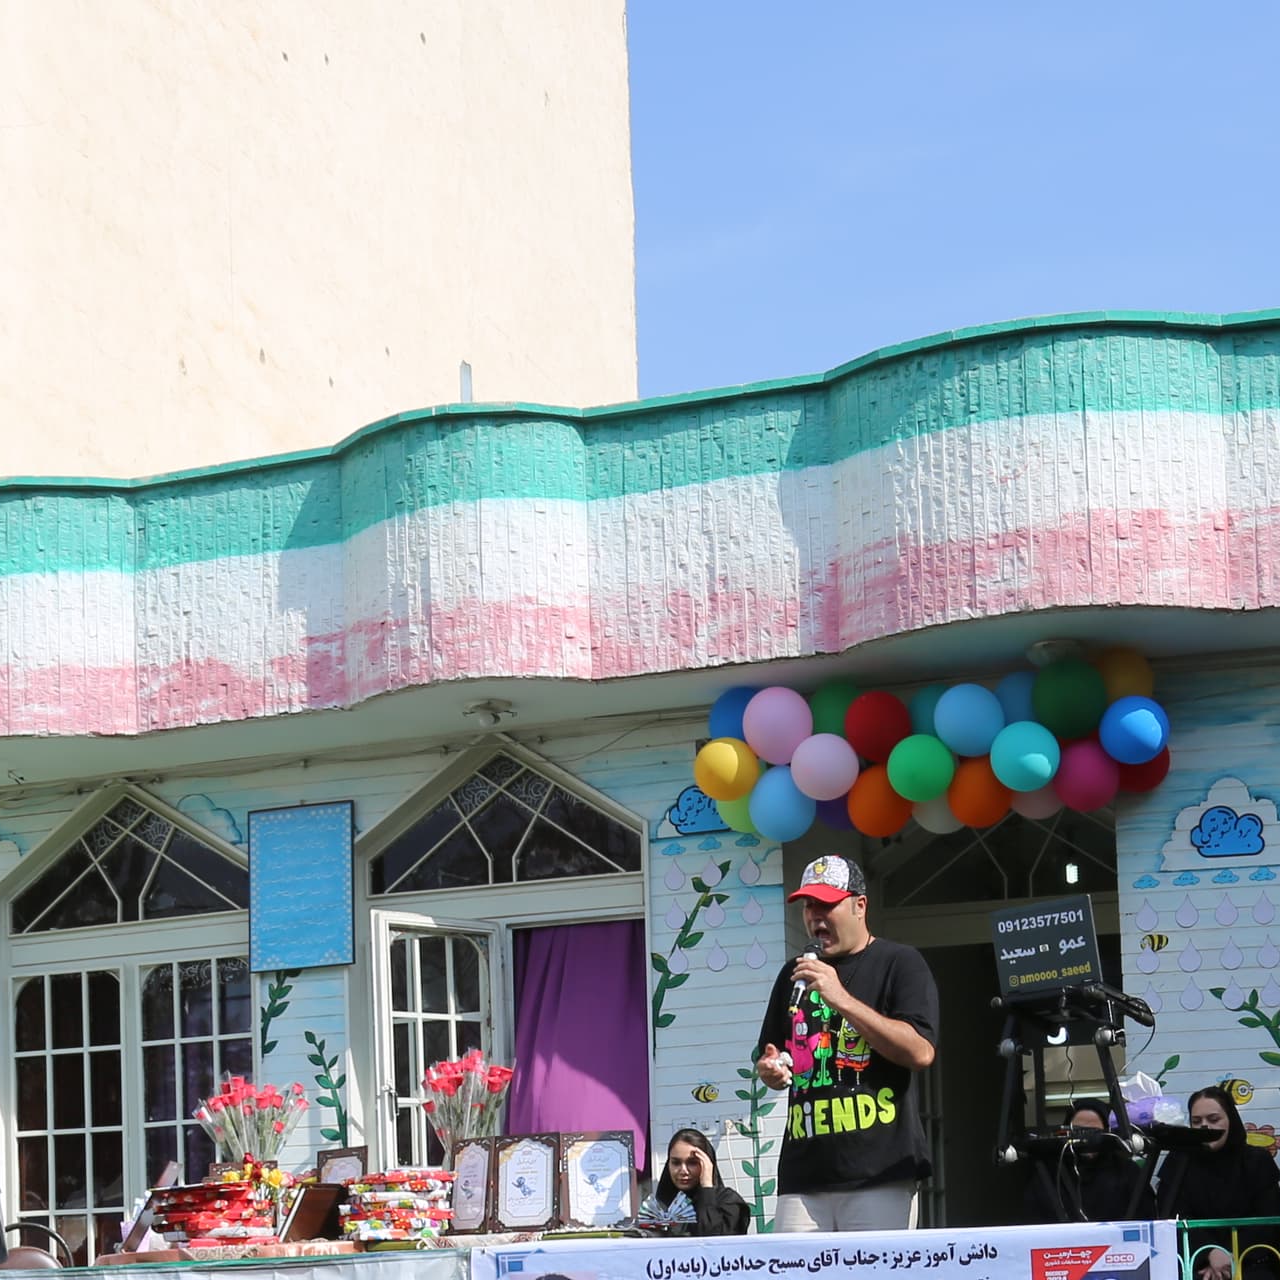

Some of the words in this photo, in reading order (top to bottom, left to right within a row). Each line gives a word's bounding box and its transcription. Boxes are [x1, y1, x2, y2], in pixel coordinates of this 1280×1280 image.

[998, 908, 1084, 933] 09123577501
[1000, 946, 1036, 965] سعید
[1058, 935, 1086, 955] عمو
[788, 1087, 896, 1141] RiENDS
[768, 1256, 806, 1274] مسیح
[807, 1248, 841, 1273] آقای
[843, 1249, 880, 1270] جناب
[923, 1242, 956, 1268] آموز
[959, 1243, 998, 1265] دانش
[709, 1255, 767, 1277] حدادیان
